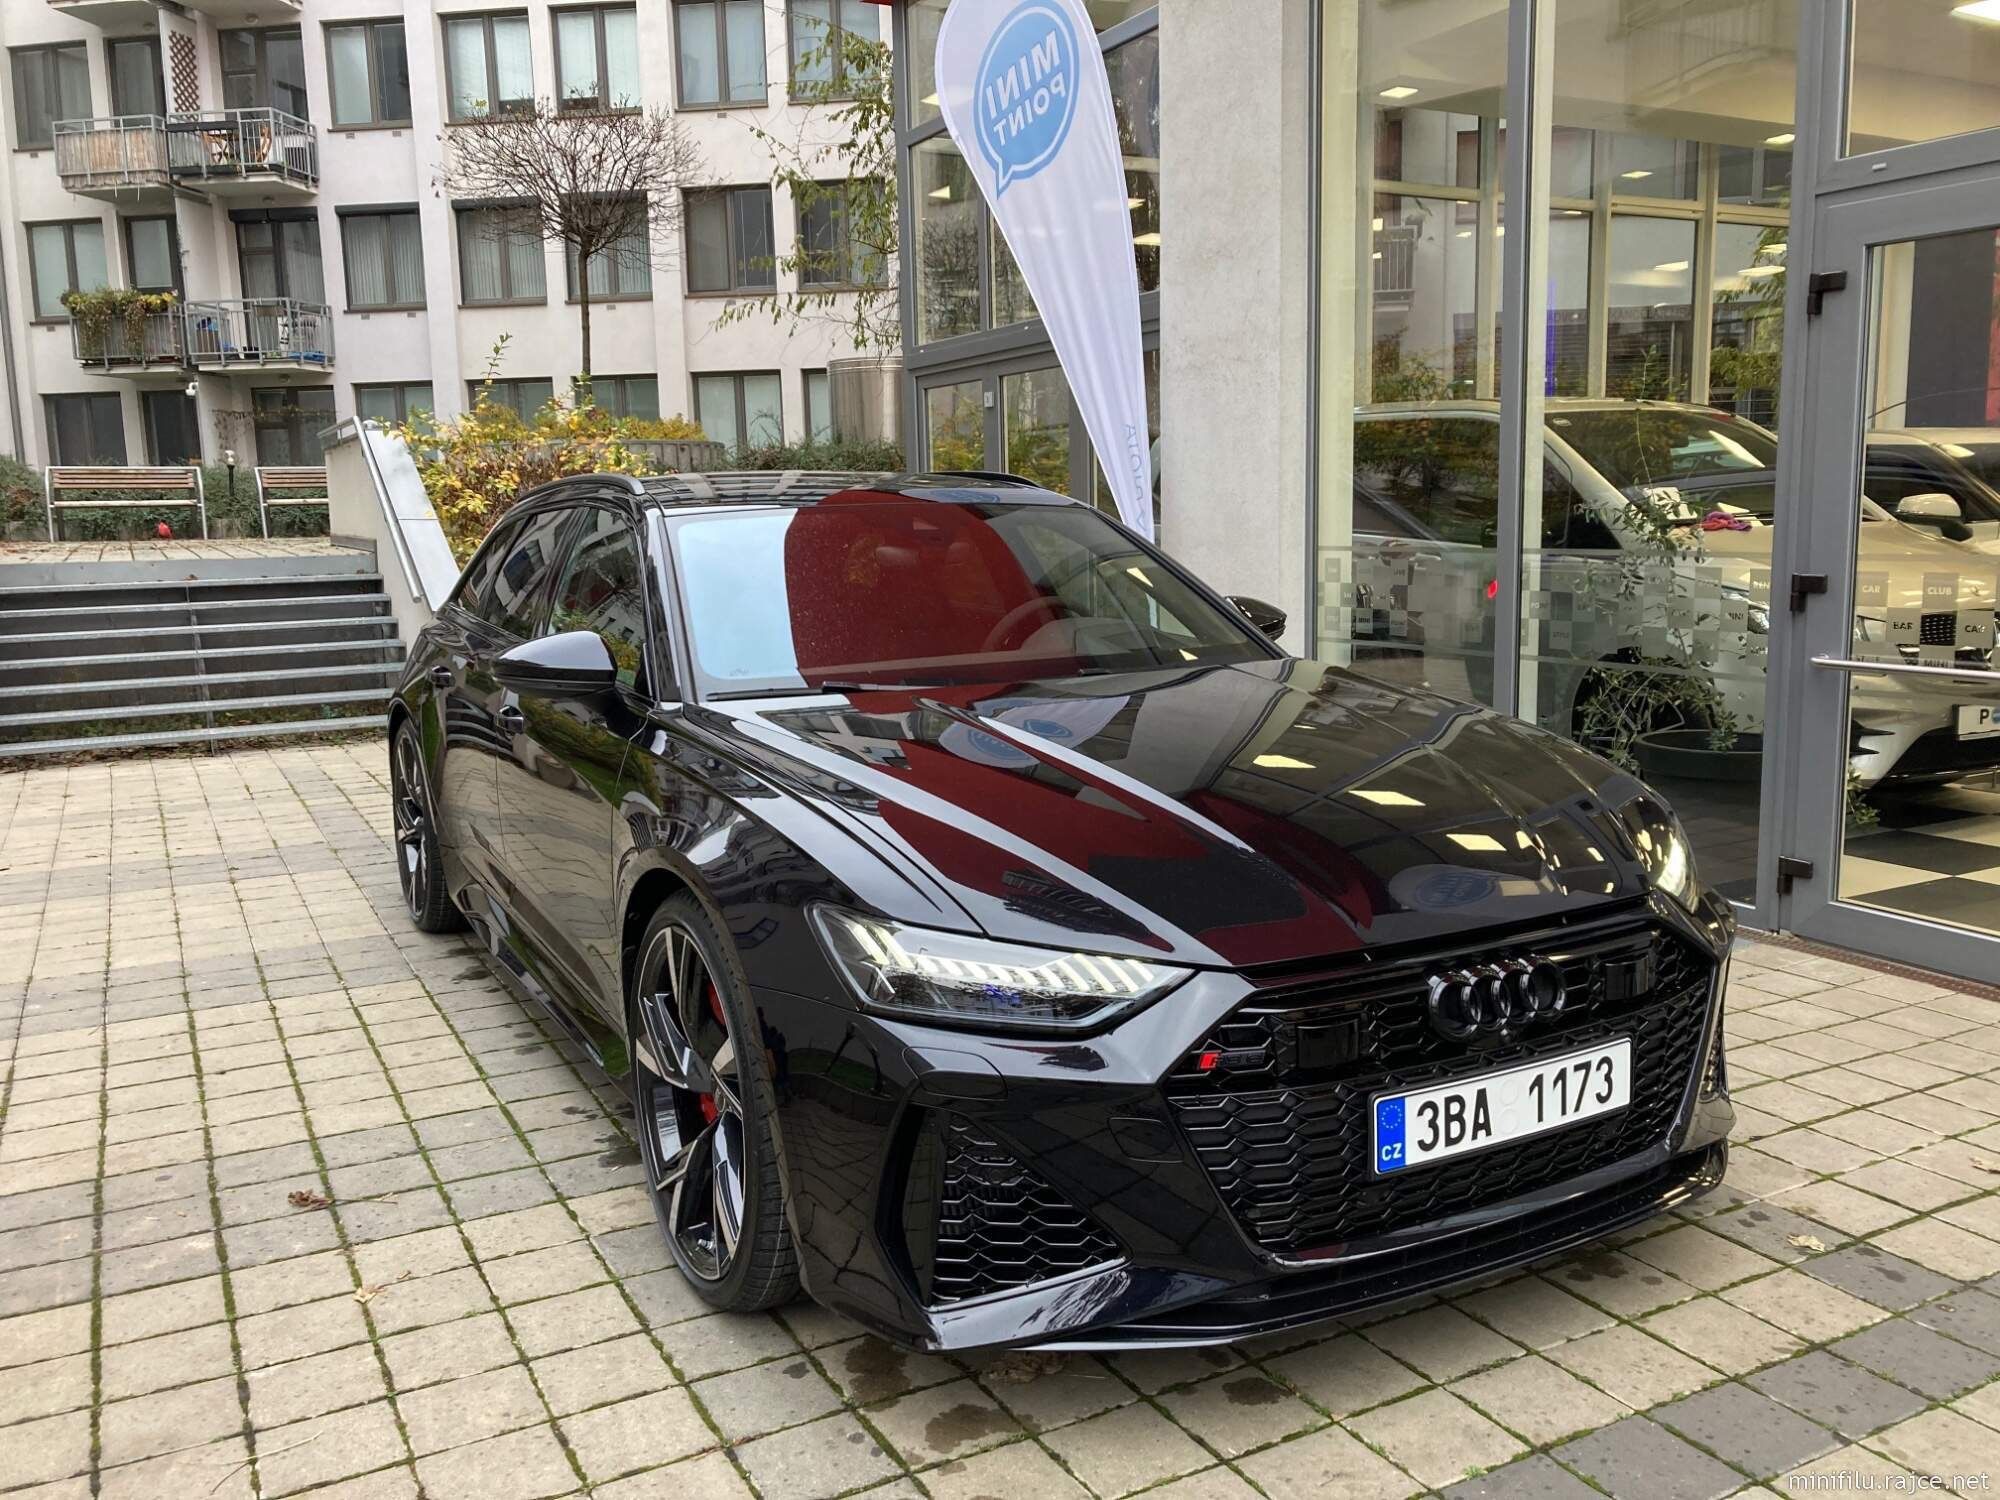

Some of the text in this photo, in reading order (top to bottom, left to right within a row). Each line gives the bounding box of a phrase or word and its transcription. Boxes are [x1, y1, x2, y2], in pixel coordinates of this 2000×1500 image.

[1862, 584, 1881, 593] CAR
[1927, 586, 1952, 595] CLUB
[1417, 1056, 1613, 1151] 3BA 1173
[1381, 1143, 1402, 1161] CZ
